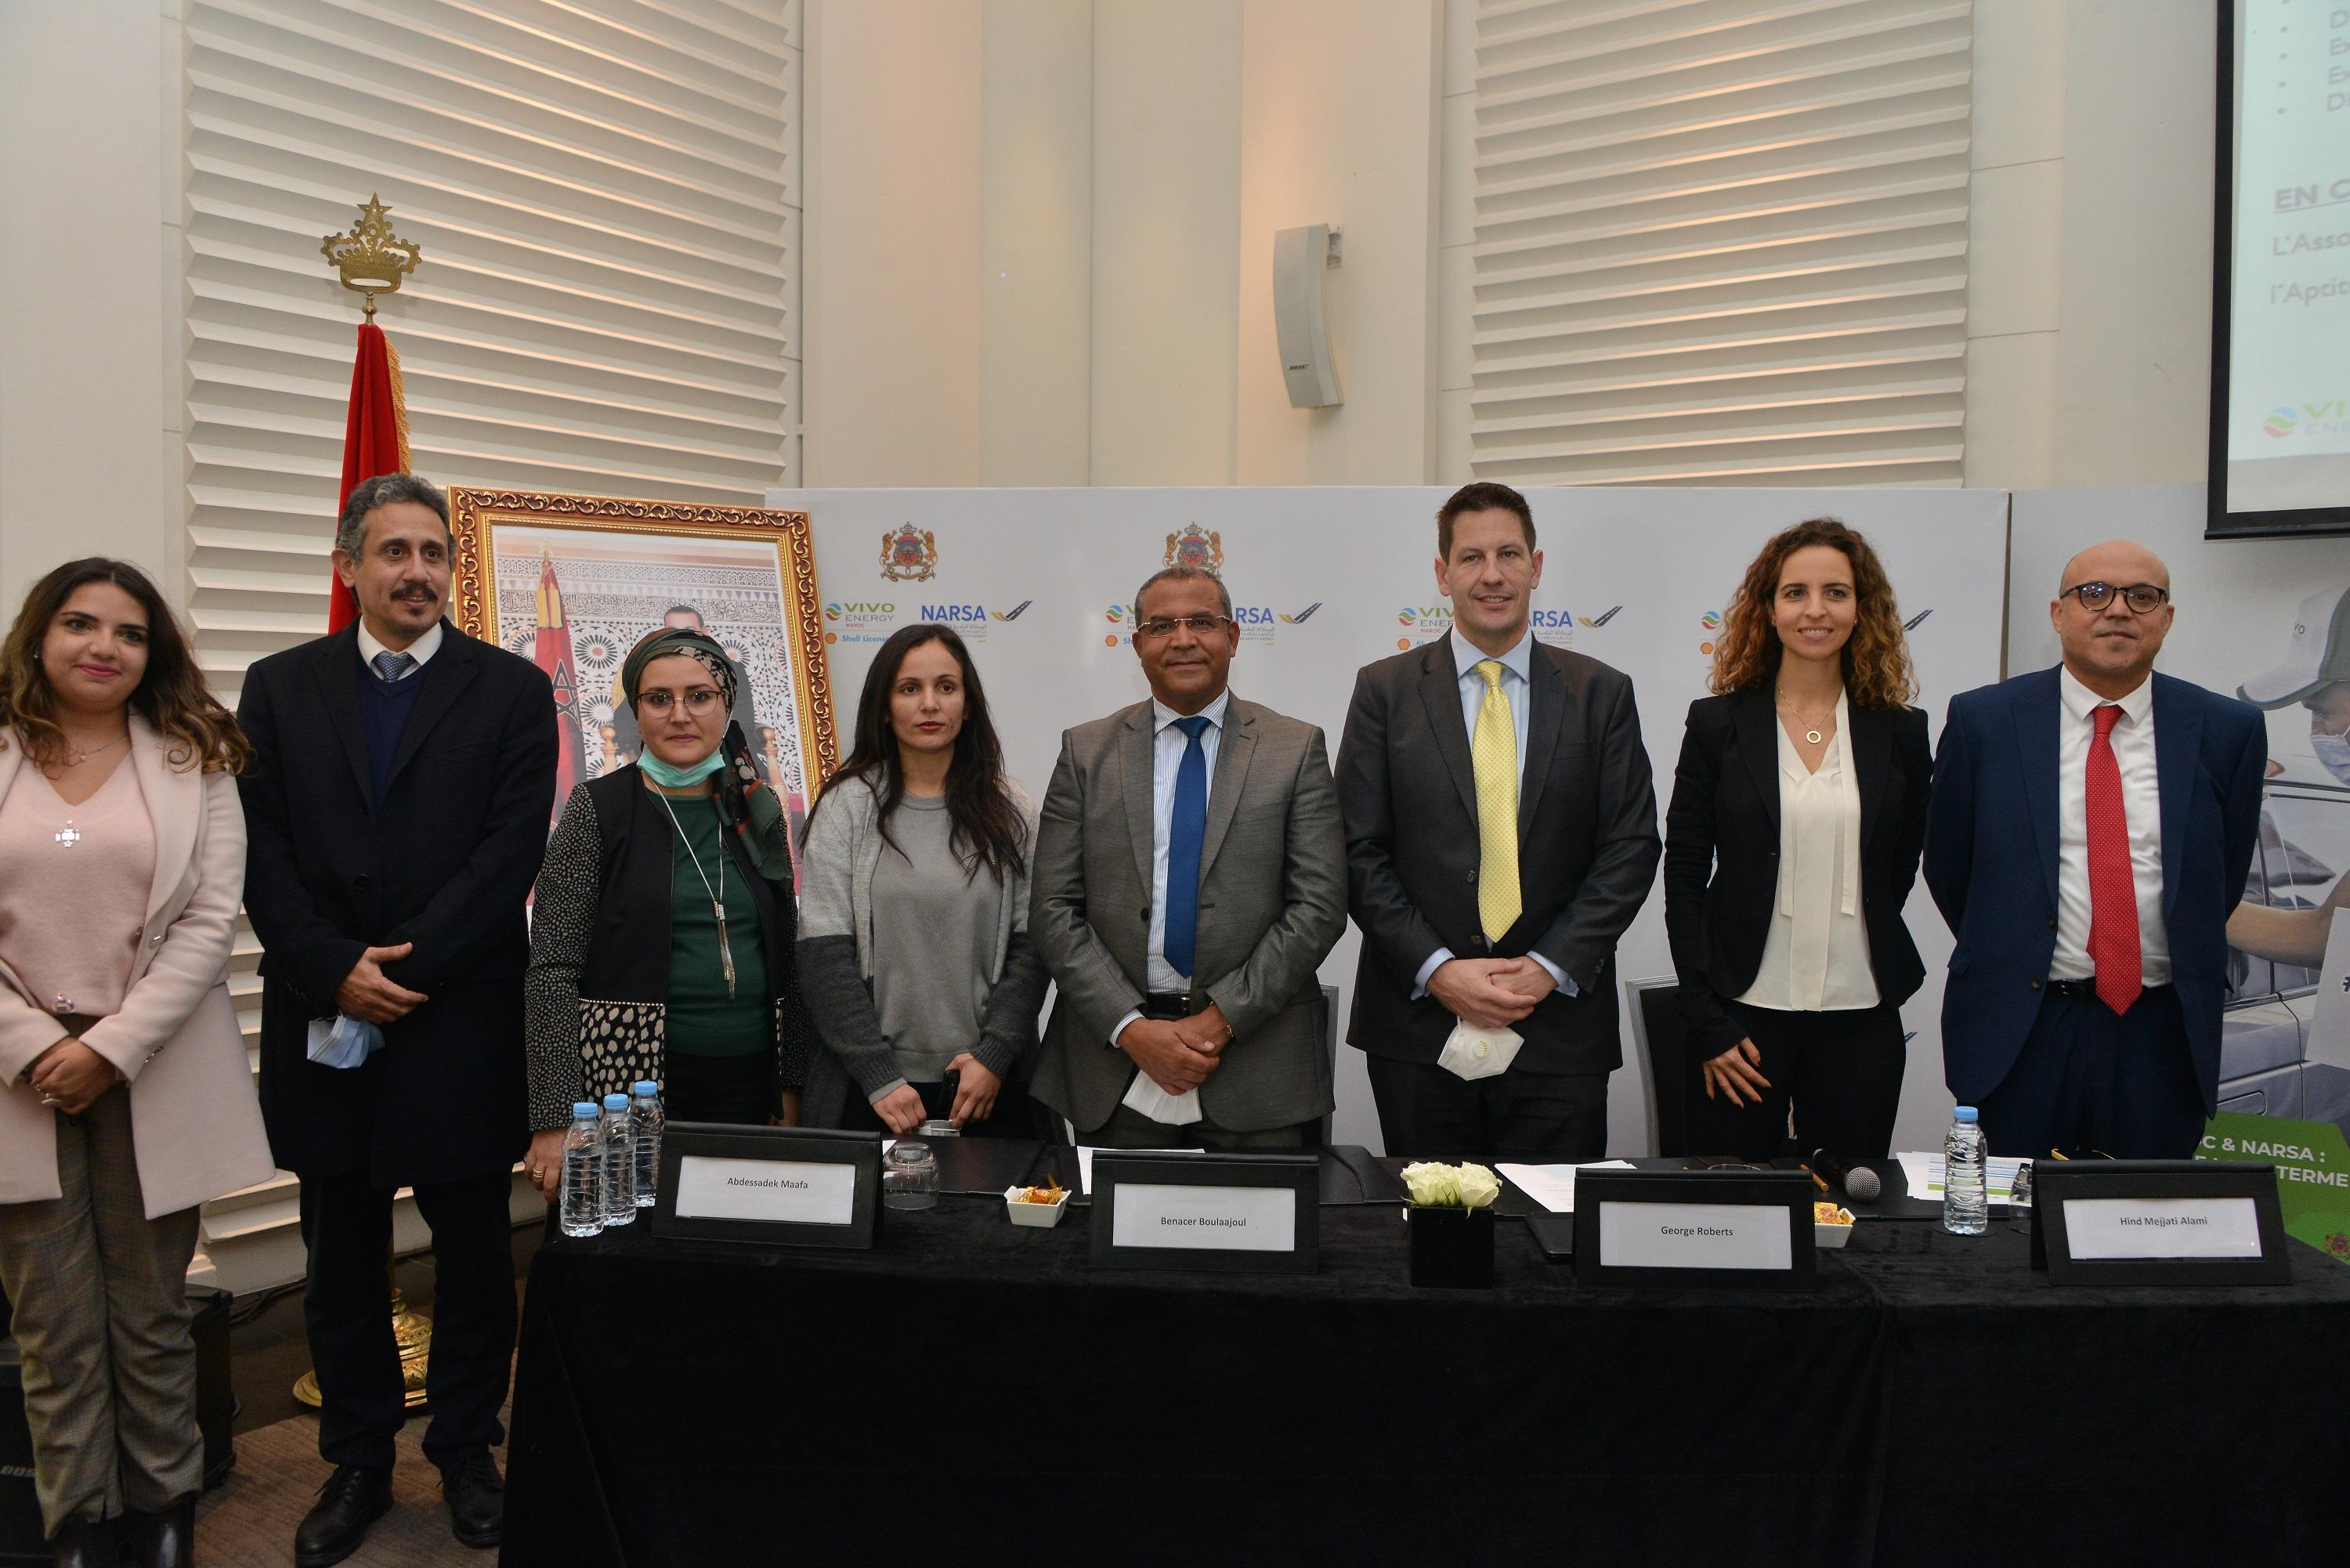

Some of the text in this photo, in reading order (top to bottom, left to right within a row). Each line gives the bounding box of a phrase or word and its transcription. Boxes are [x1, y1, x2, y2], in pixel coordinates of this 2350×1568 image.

[2275, 183, 2318, 210] EN
[844, 602, 895, 613] VIVO
[921, 605, 987, 622] NARSA
[1529, 610, 1573, 627] RSA
[2222, 1137, 2236, 1151] &
[2242, 1140, 2315, 1162] NARSA
[727, 1177, 808, 1189] Abdessadek Maafa
[2276, 1165, 2349, 1187] TERME
[1161, 1217, 1246, 1228] Benacer Boulaajoul
[2120, 1216, 2207, 1227] Hind Mejjati Alami
[1661, 1226, 1734, 1237] George Roberts
